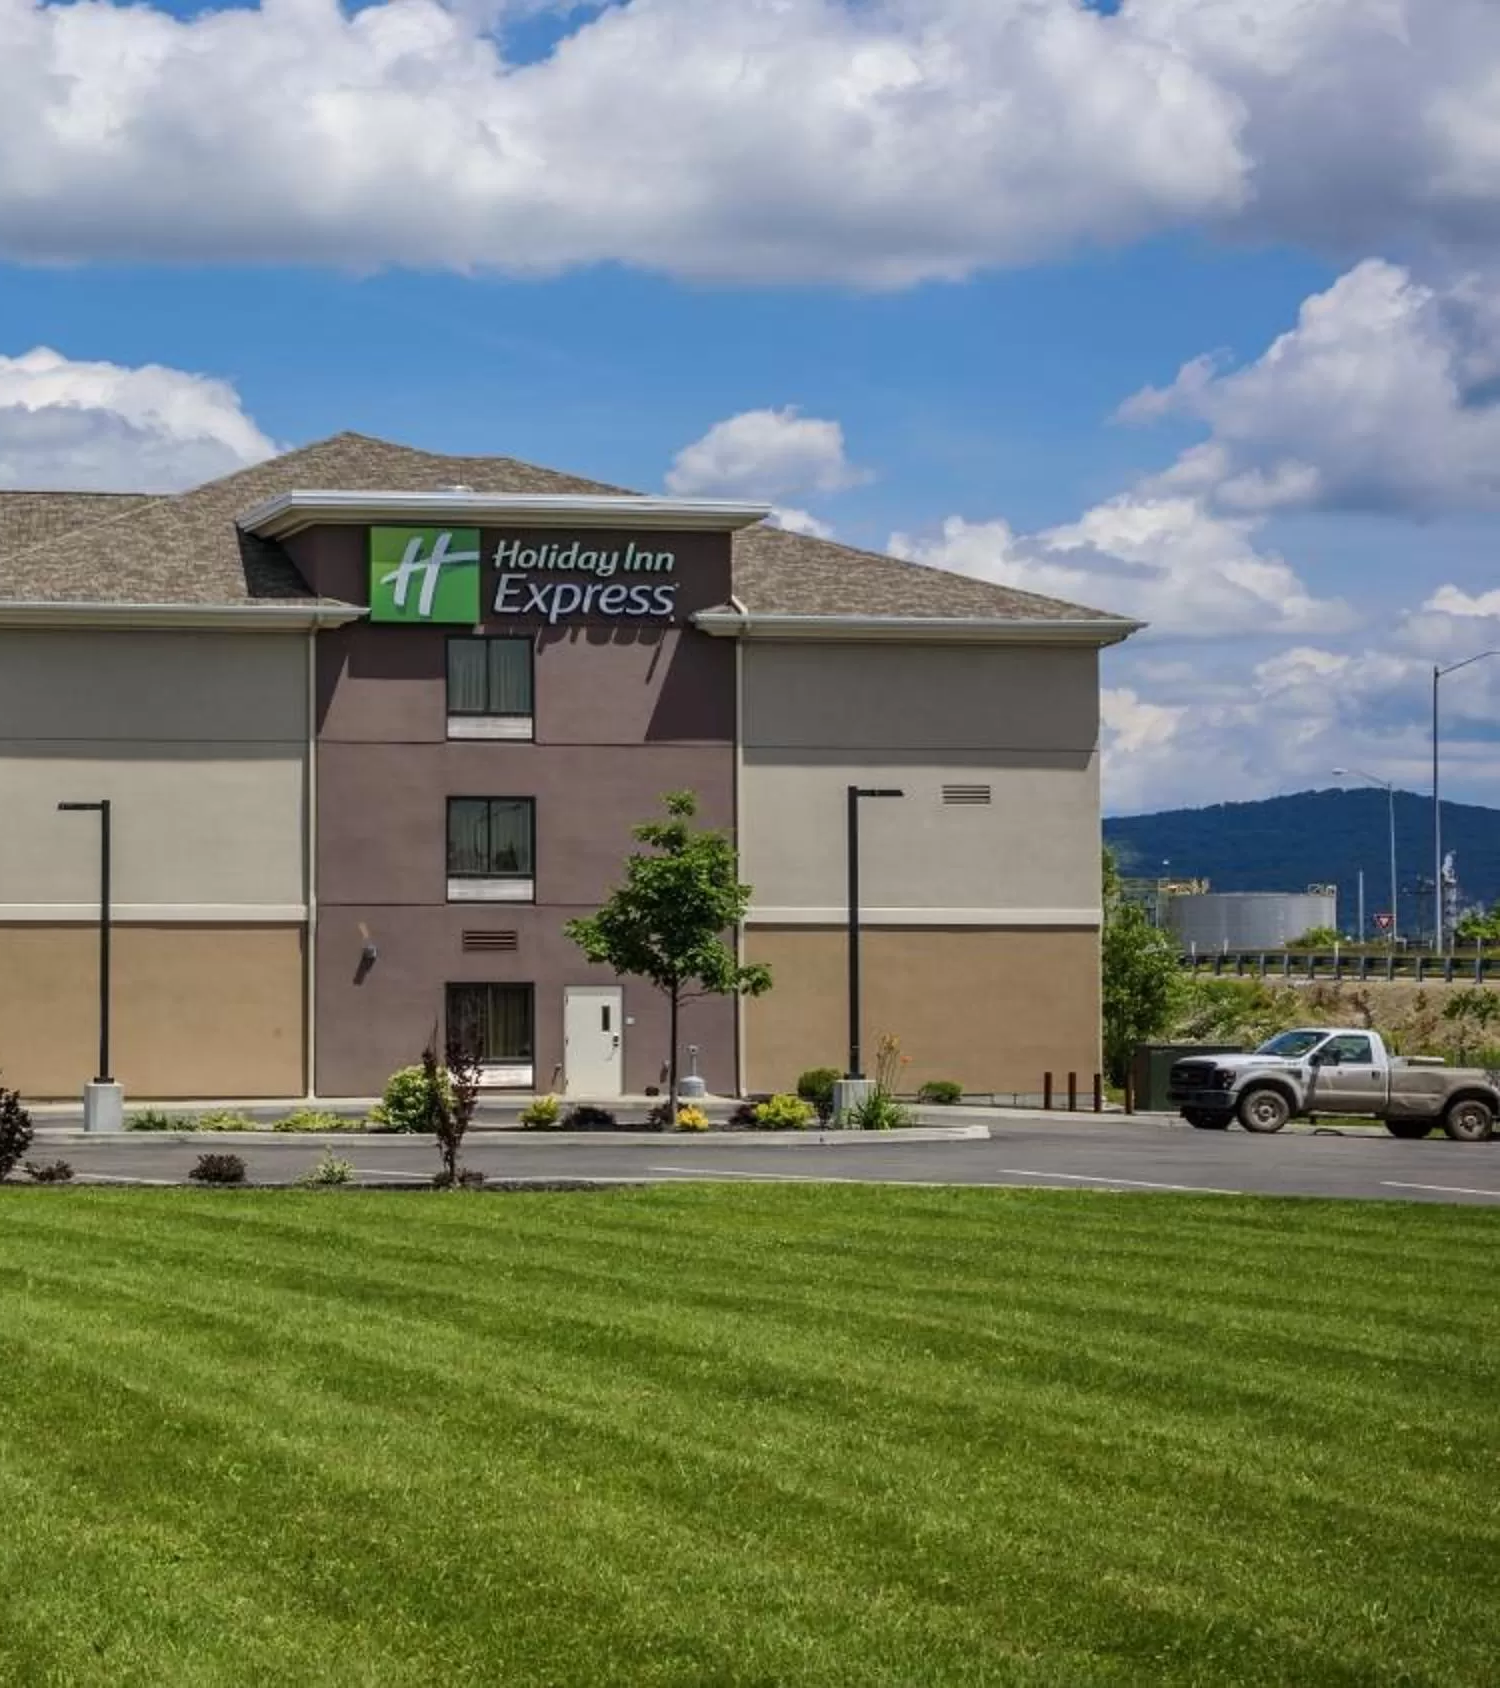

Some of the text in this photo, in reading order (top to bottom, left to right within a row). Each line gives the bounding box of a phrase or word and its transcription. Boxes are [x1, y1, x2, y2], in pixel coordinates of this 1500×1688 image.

[492, 539, 675, 577] Holiday Inn
[493, 572, 676, 625] Express
